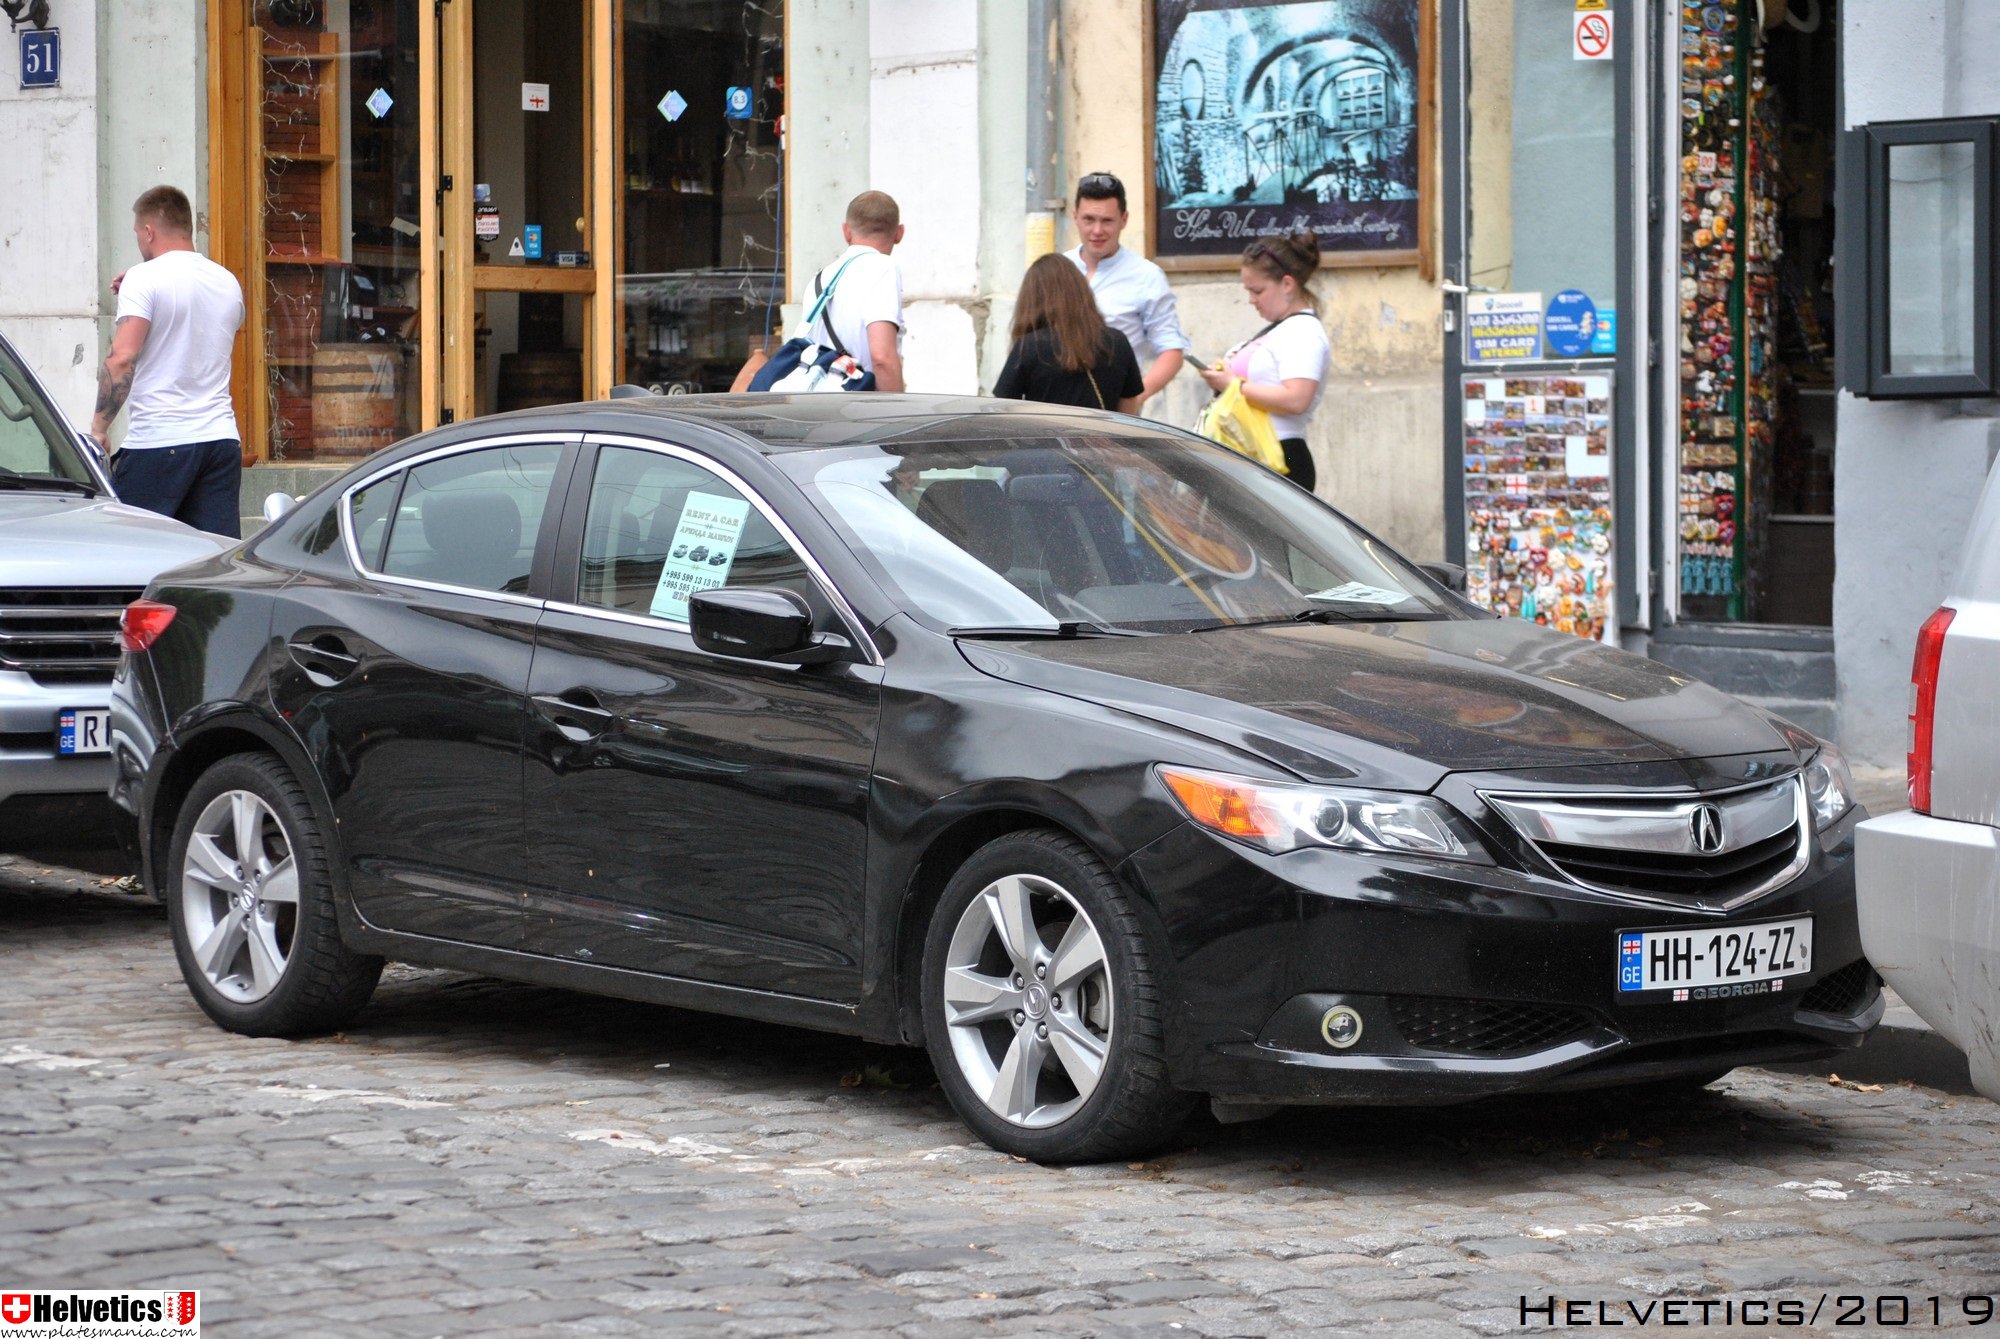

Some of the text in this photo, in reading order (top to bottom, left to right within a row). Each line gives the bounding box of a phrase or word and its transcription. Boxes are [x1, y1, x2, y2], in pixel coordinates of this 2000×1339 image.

[26, 43, 54, 74] 51
[733, 95, 746, 104] 8.3
[1474, 337, 1536, 349] SIM CARD
[1480, 347, 1532, 358] INTERNET
[685, 508, 739, 527] RENT A CAR
[662, 580, 678, 589] +995
[666, 570, 681, 580] +995
[682, 573, 693, 582] 599
[694, 576, 702, 585] 13
[703, 578, 711, 586] 13
[60, 735, 75, 748] GE
[1650, 926, 1795, 983] HH-124-ZZ
[1622, 966, 1641, 984] GE
[1693, 981, 1769, 1000] GEORGIA
